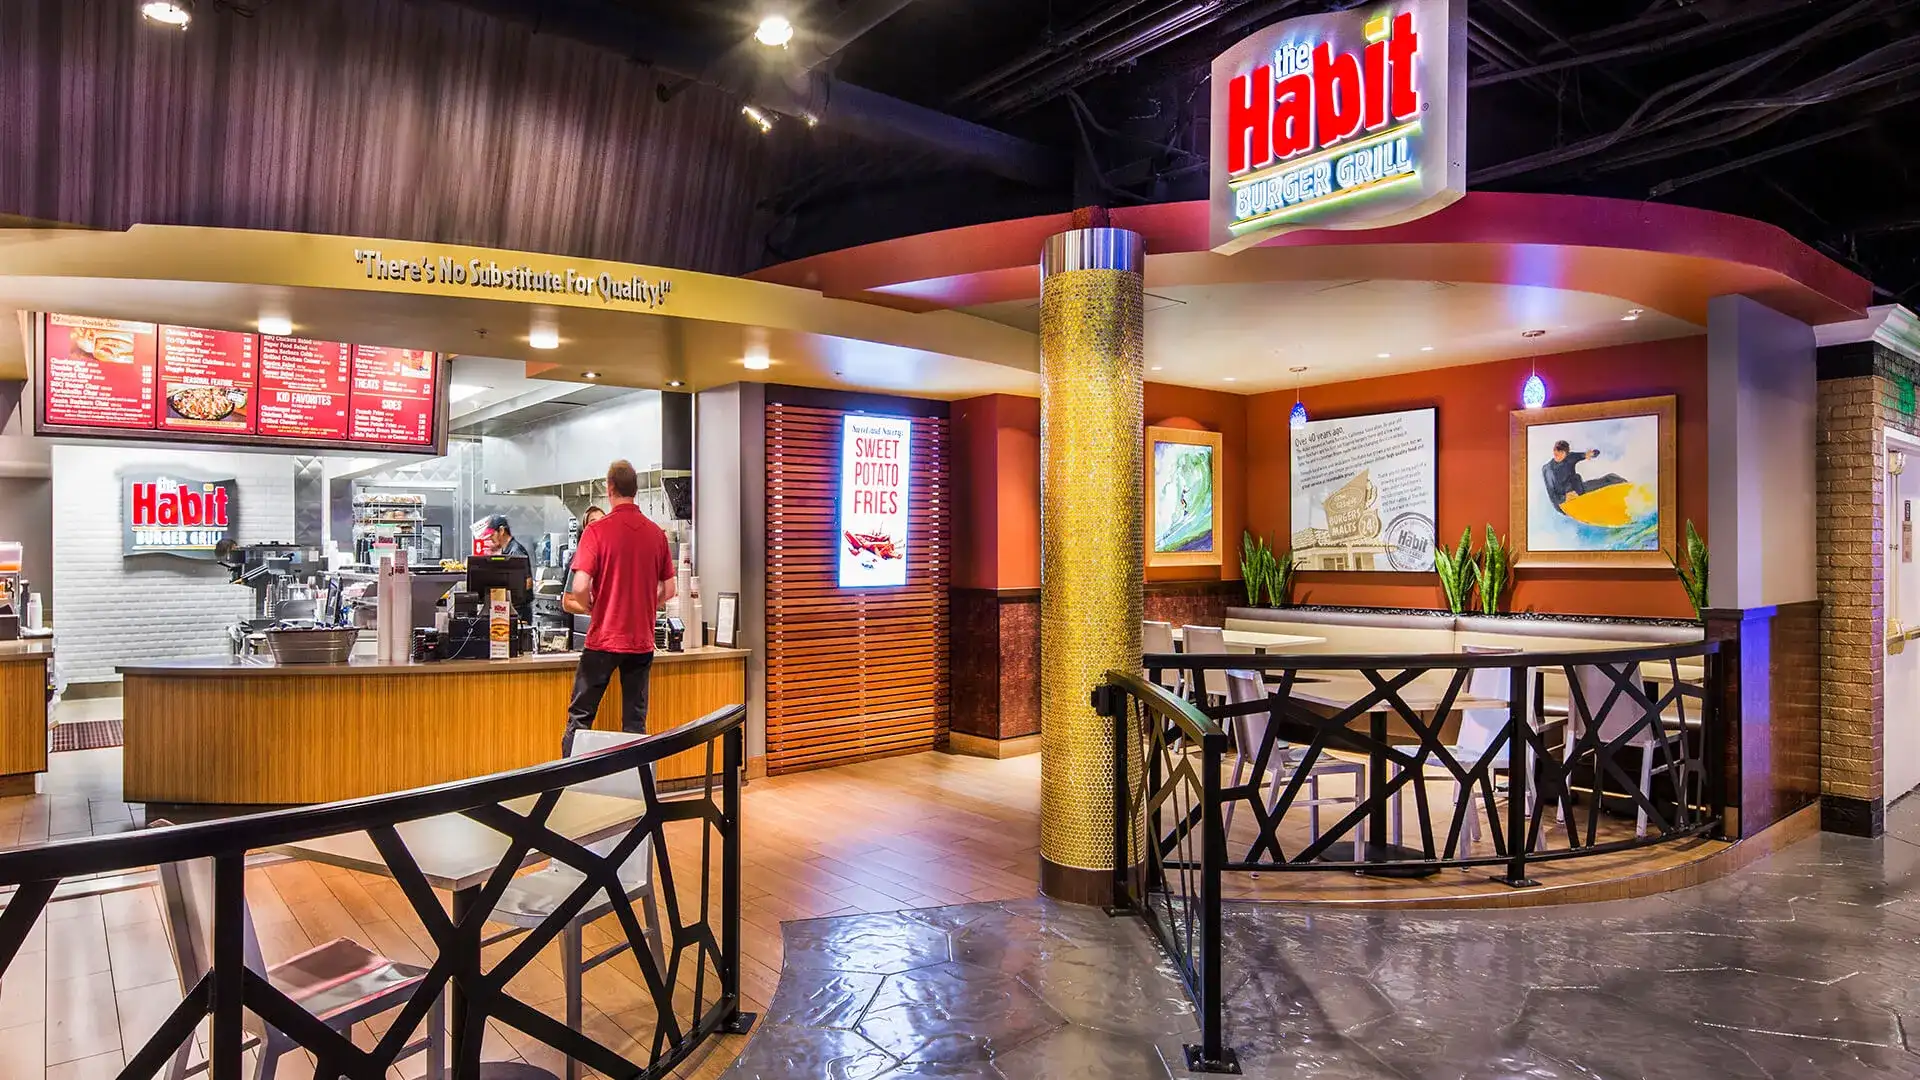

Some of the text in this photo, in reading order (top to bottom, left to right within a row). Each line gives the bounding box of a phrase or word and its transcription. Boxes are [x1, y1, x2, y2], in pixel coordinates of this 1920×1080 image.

[1274, 42, 1311, 80] the
[1228, 12, 1420, 175] Habit
[1236, 137, 1412, 219] BURGER GRILL
[354, 249, 672, 308] "There's No Substitute For Quality!"
[277, 392, 332, 406] KID FAVORITES
[382, 400, 402, 410] SIDES
[856, 438, 899, 459] SWEET
[1295, 436, 1307, 447] Over
[1308, 432, 1316, 442] 40
[1317, 430, 1332, 440] years
[855, 462, 899, 487] POTATO
[132, 482, 228, 526] Habit
[854, 490, 898, 515] FRIES
[1330, 508, 1361, 526] BURGERS
[136, 531, 187, 545] BURGER
[1332, 522, 1357, 537] MALTS
[1398, 529, 1429, 553] Habit
